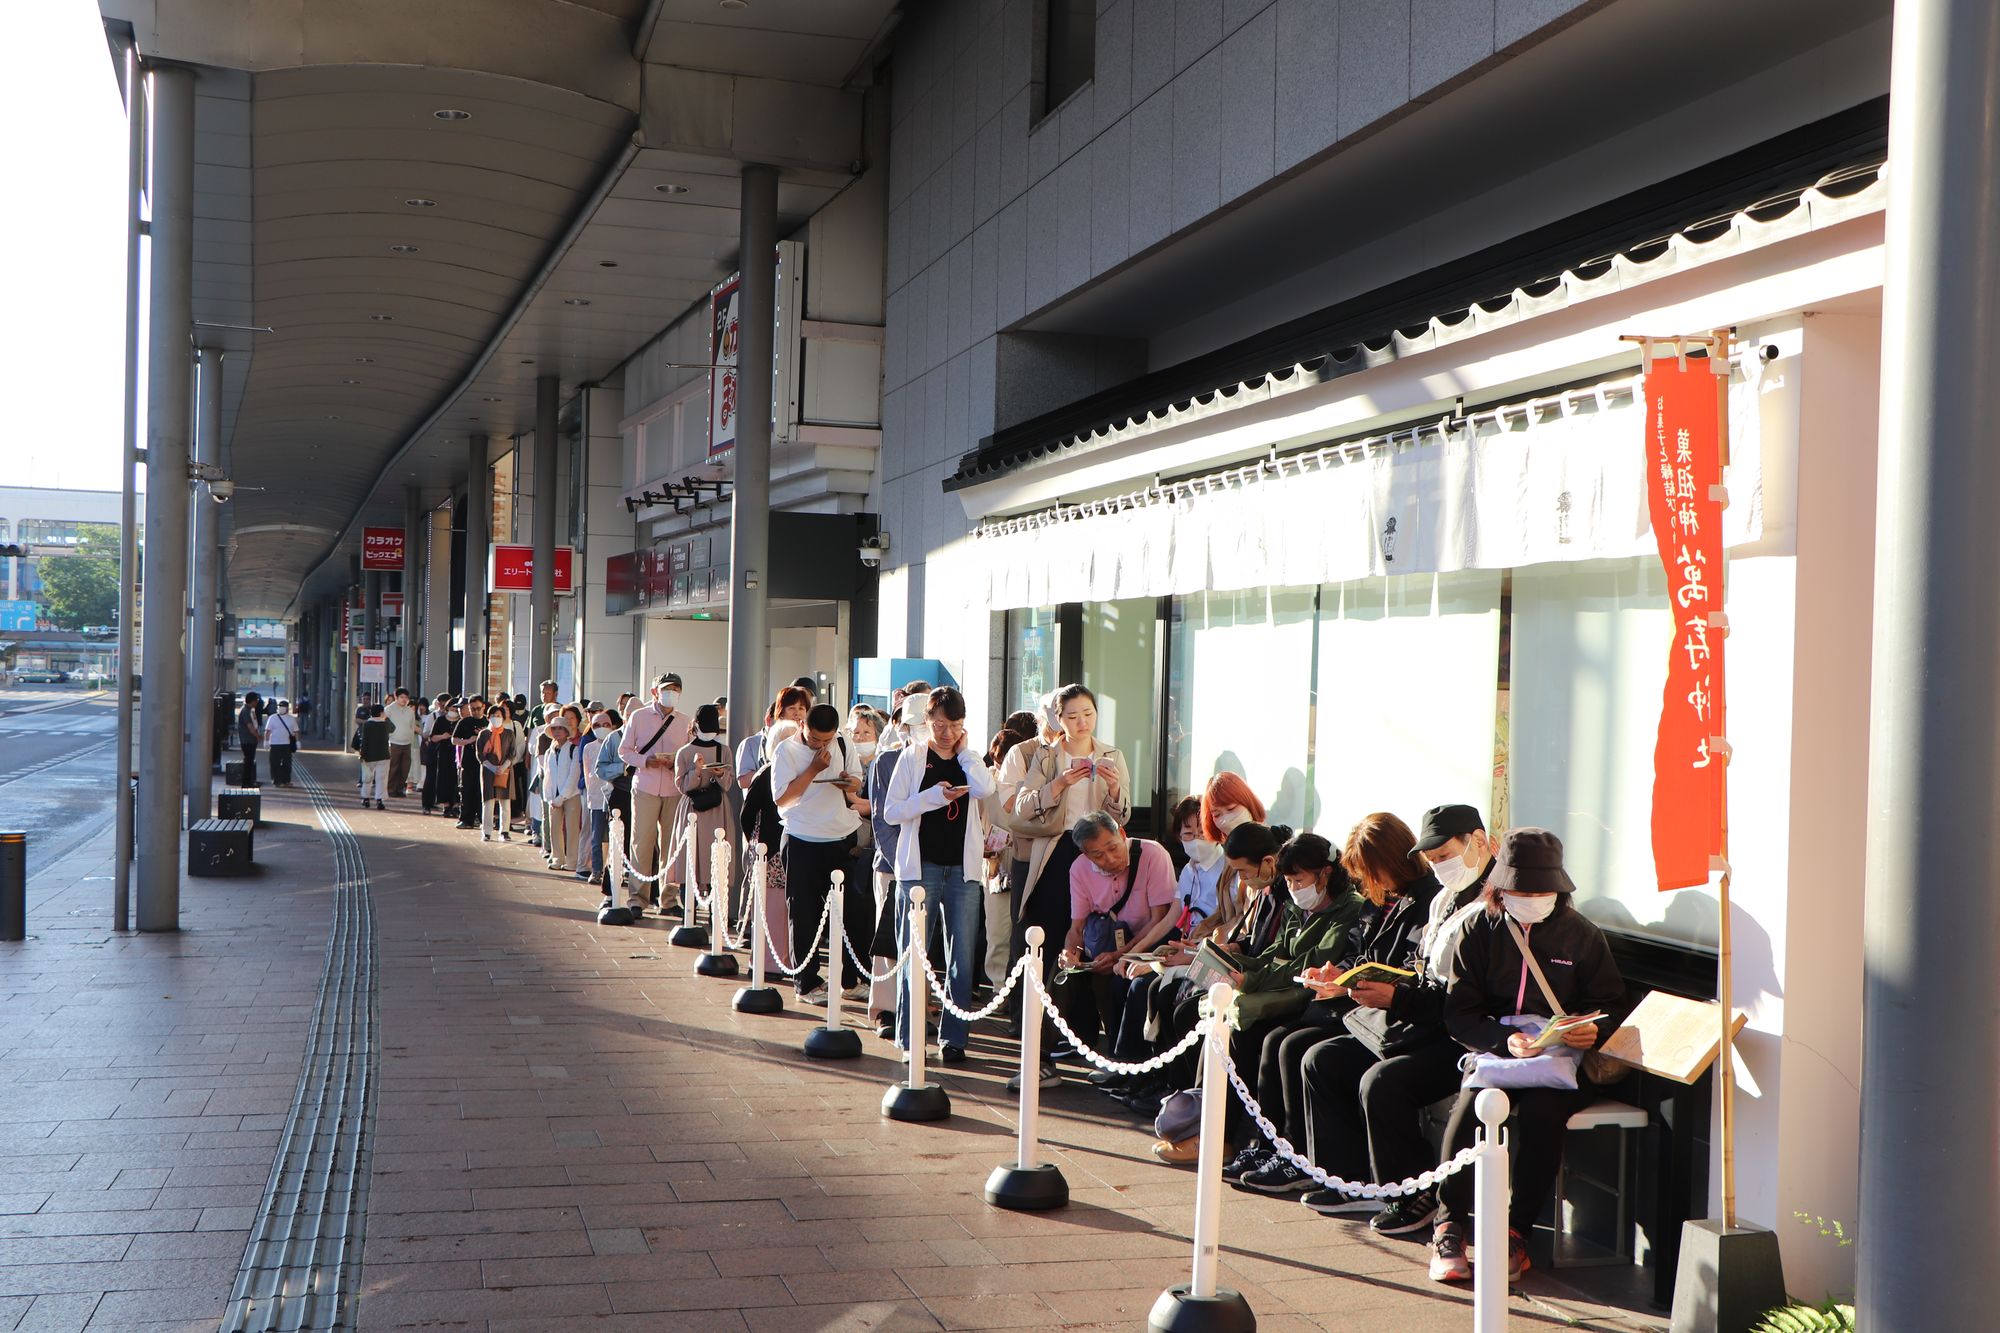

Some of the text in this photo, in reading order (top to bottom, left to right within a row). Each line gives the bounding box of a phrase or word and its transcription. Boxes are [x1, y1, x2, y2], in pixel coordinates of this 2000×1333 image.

[717, 308, 727, 331] 2F
[367, 536, 403, 546] カラオケ
[1283, 1166, 1297, 1178] N
